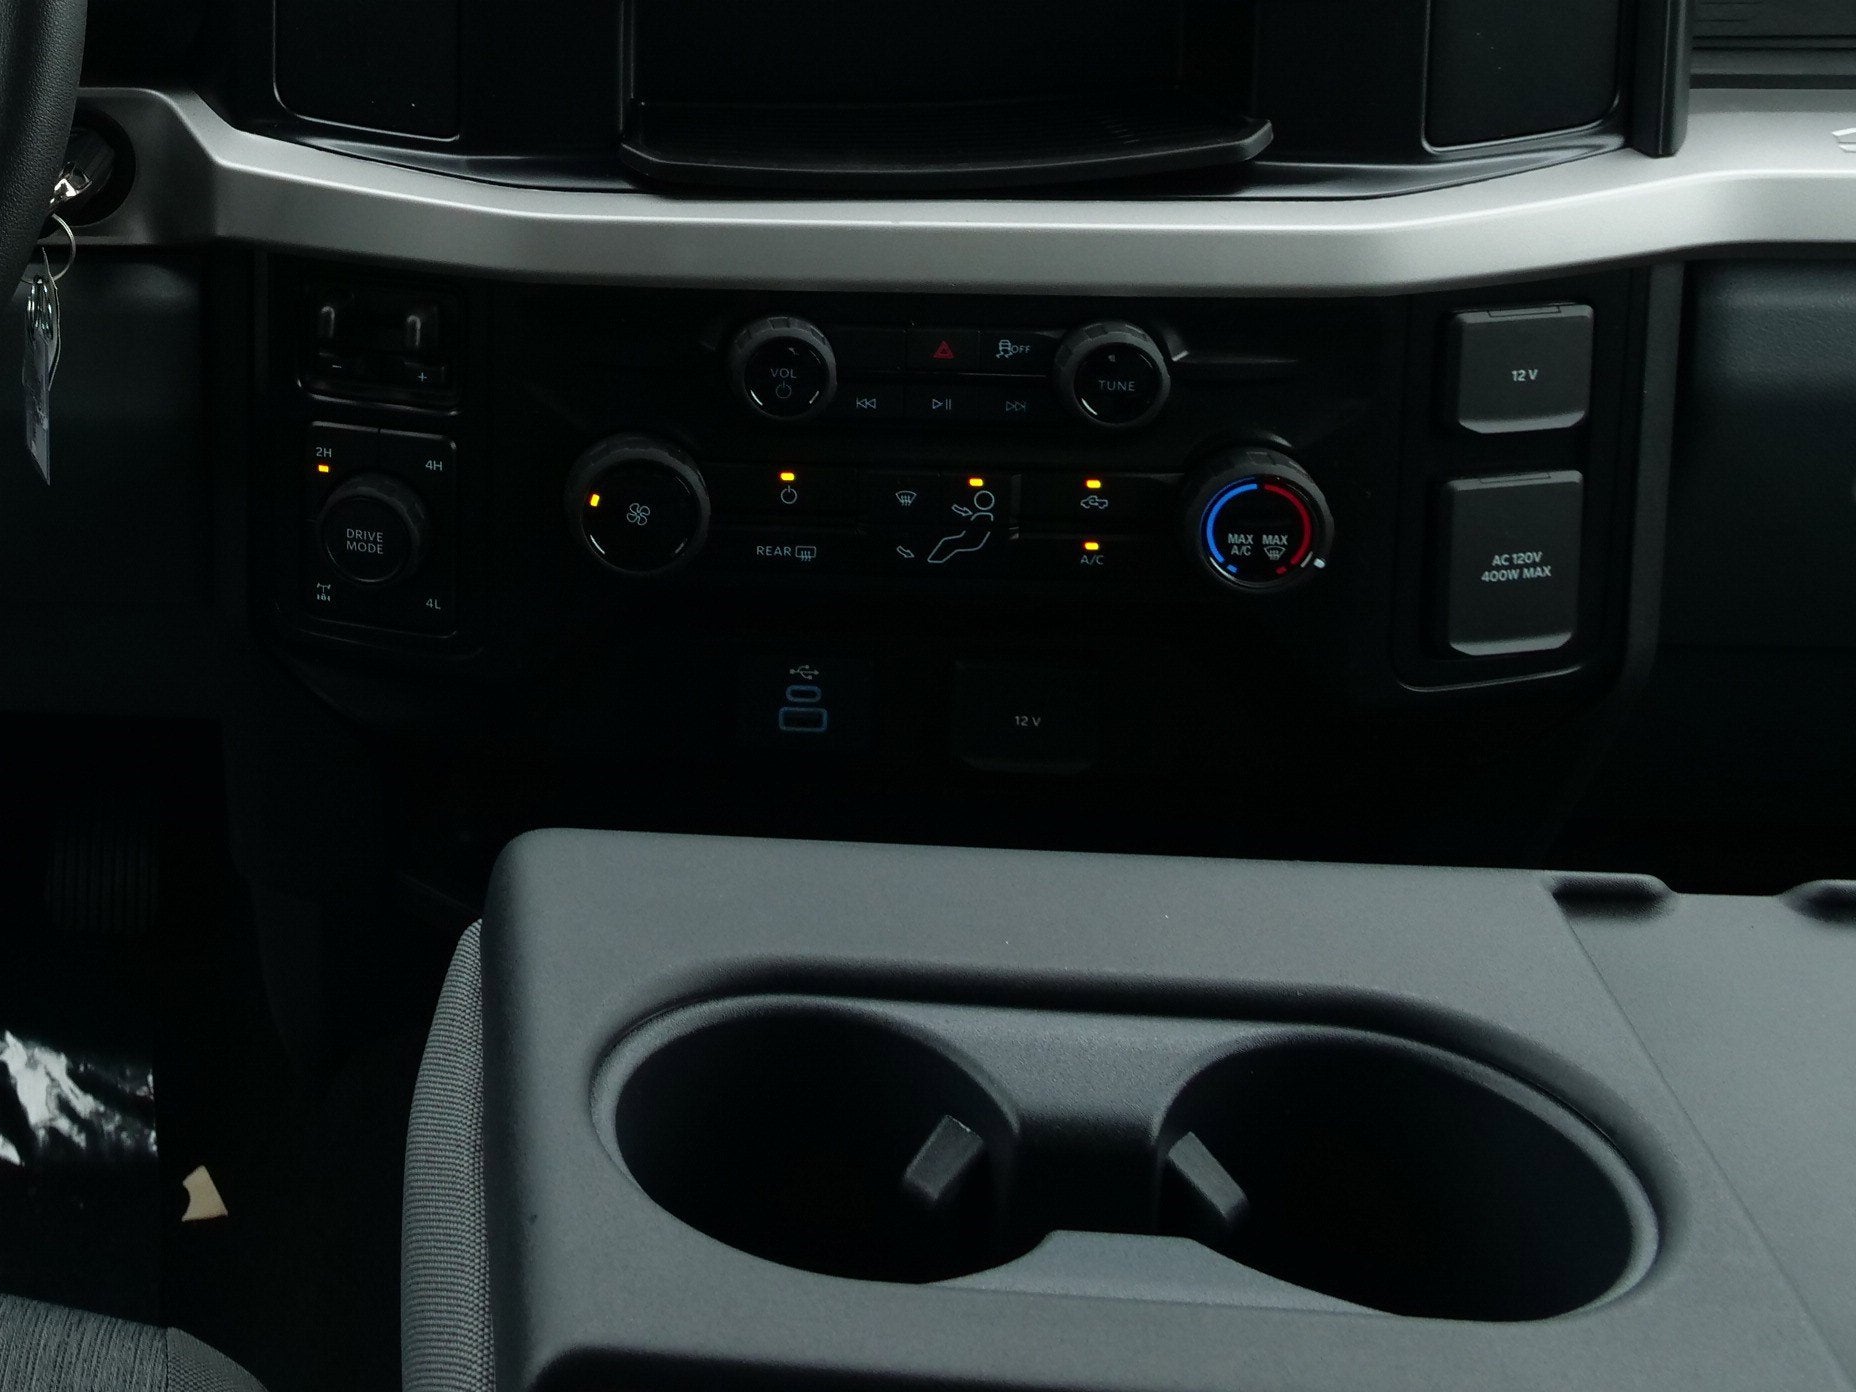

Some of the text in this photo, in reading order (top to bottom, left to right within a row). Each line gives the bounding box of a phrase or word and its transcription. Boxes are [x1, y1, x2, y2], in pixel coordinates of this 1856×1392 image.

[1011, 344, 1031, 355] OFF
[770, 368, 797, 379] VOL
[1511, 369, 1538, 382] 12 V
[1098, 379, 1136, 393] TUNE
[316, 447, 332, 458] 2H
[425, 460, 443, 471] 4H
[346, 528, 383, 543] DRIVE
[1227, 533, 1254, 545] MAX
[1262, 534, 1288, 546] MAX
[346, 540, 384, 555] MODE
[756, 545, 792, 557] REAR
[1231, 545, 1251, 556] A/C
[1080, 555, 1104, 566] A/C
[1492, 551, 1543, 567] AC 120V
[1481, 565, 1551, 583] 400W MAX
[425, 599, 441, 610] 4L
[1014, 716, 1041, 727] 12 V
